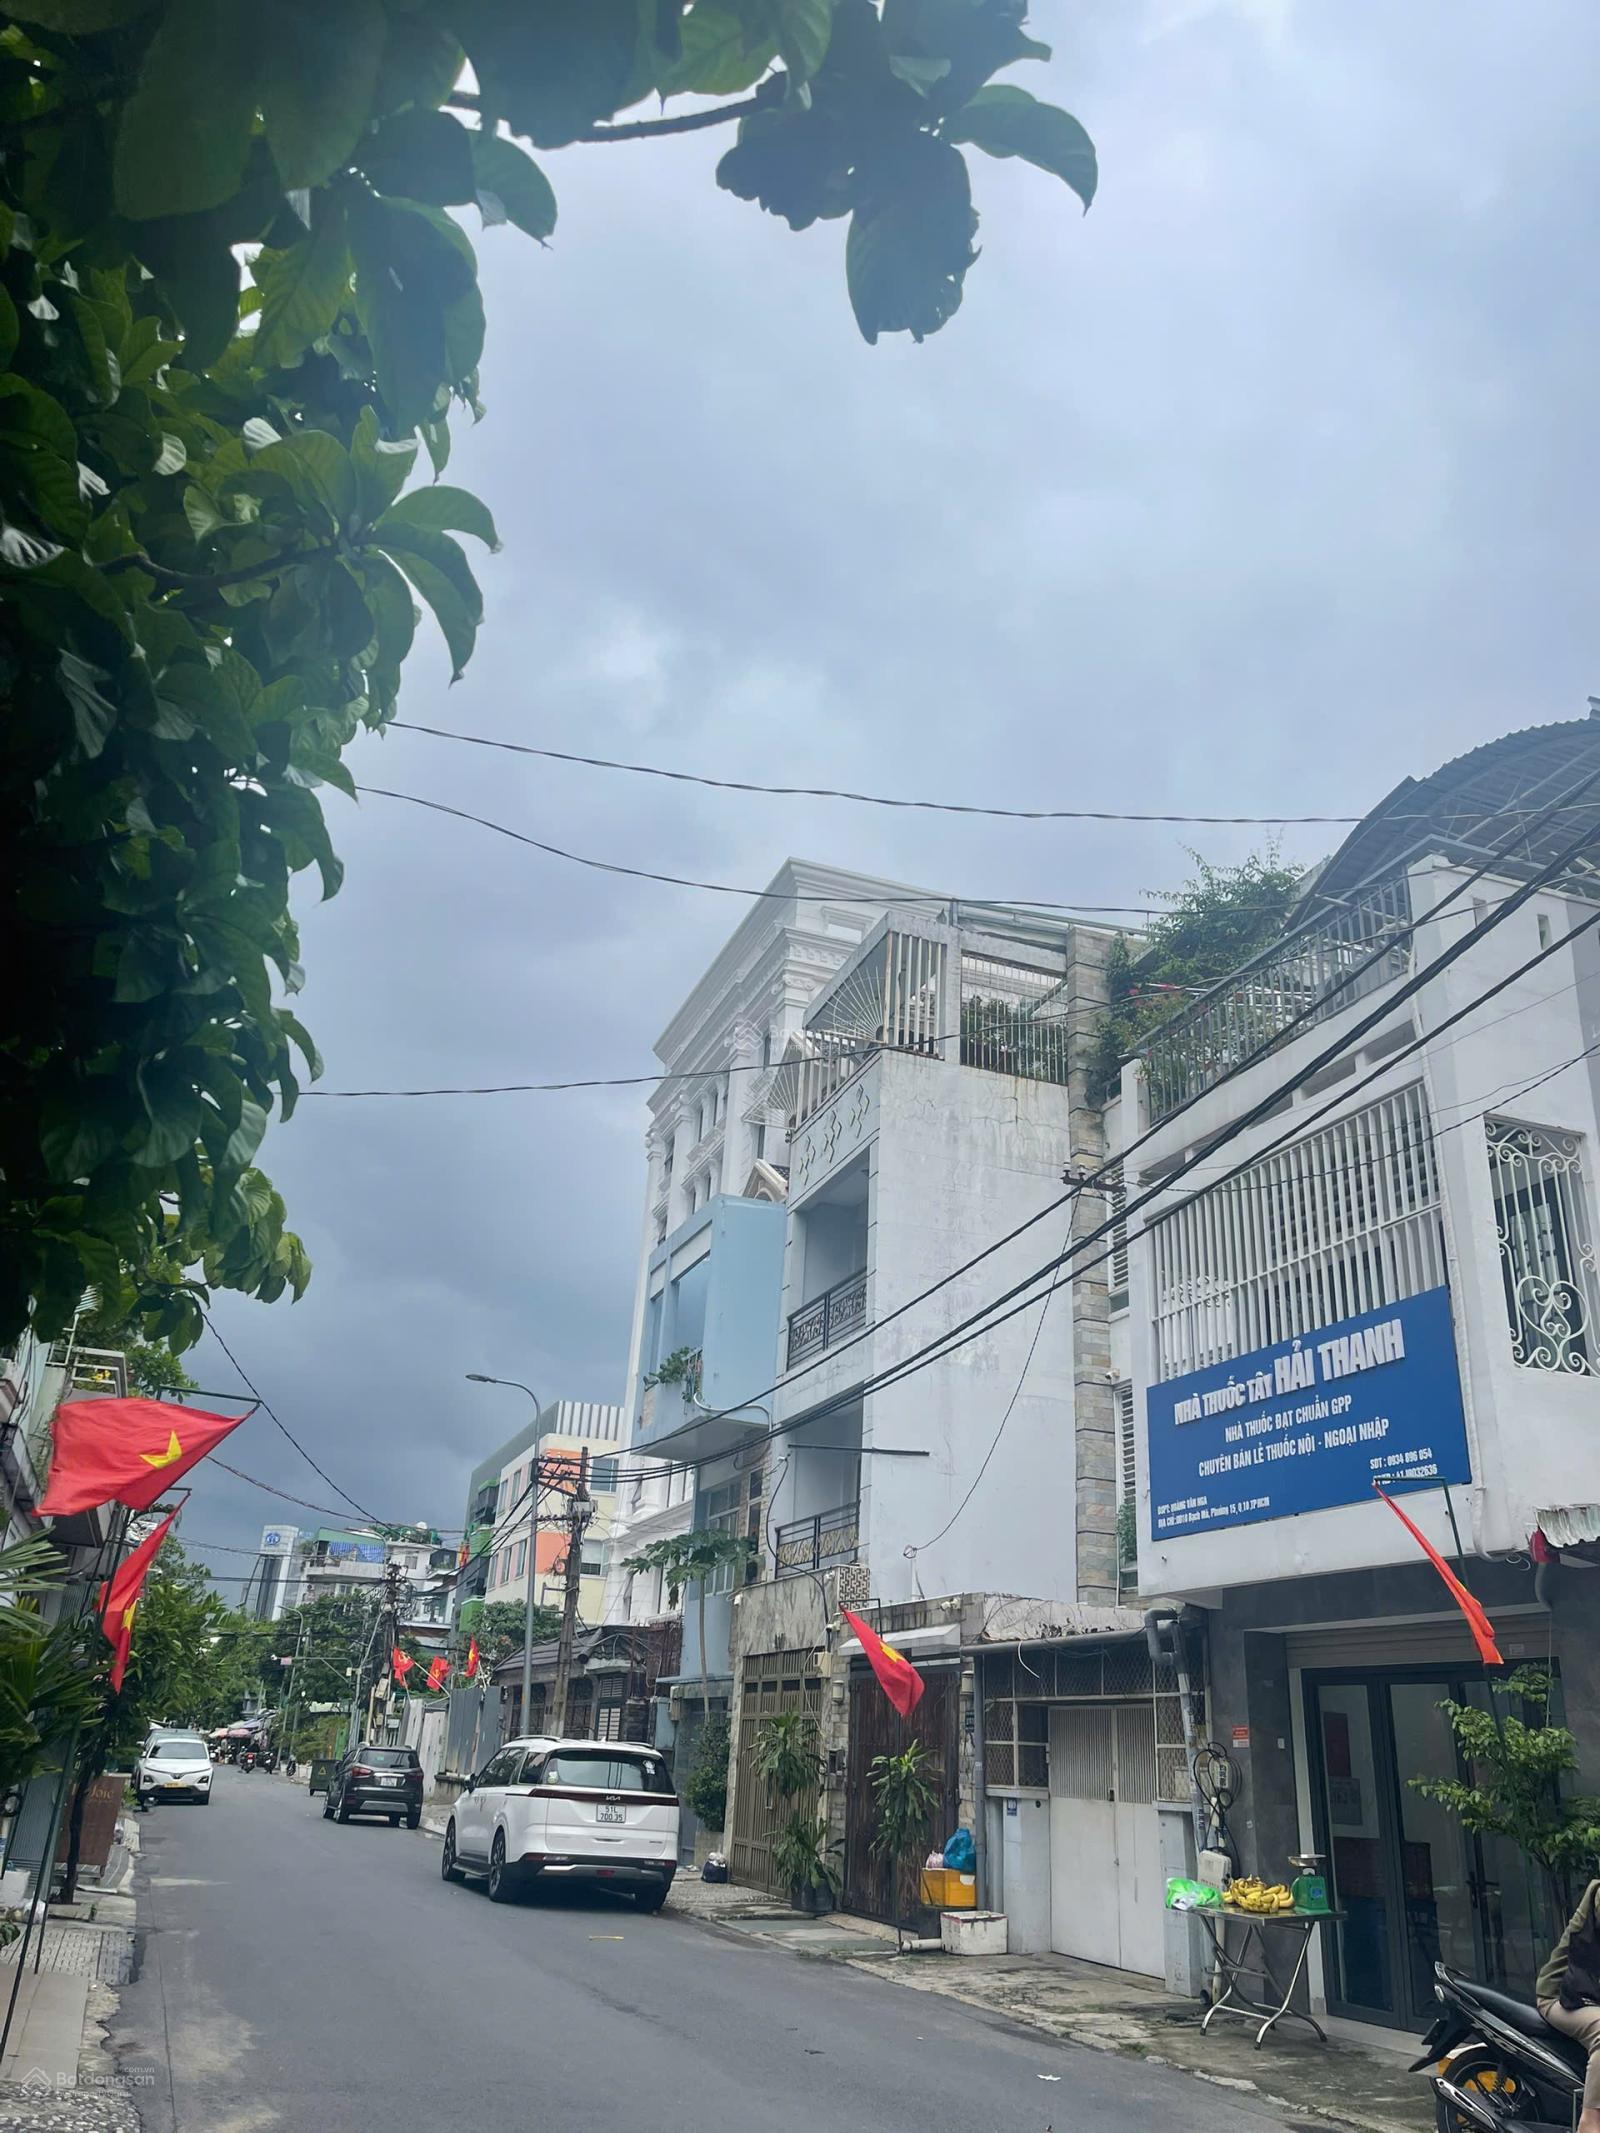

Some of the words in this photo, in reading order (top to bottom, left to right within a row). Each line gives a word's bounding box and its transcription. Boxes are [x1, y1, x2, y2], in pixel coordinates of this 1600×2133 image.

[1174, 1392, 1202, 1425] NHÀ
[1202, 1375, 1246, 1417] THUỐC
[1246, 1371, 1273, 1403] TÂY
[1274, 1339, 1315, 1395] HẢI
[1317, 1318, 1406, 1382] THANH
[1198, 1451, 1232, 1477] CHUYÊN
[1233, 1446, 1253, 1470] BÁN
[1253, 1442, 1265, 1464] LẺ
[1266, 1433, 1297, 1461] THUỐC
[1297, 1434, 1316, 1457] NỘI
[1324, 1428, 1358, 1450] NGOẠI
[1359, 1416, 1389, 1442] NHẬP
[1225, 1426, 1244, 1443] NHÀ
[1245, 1410, 1273, 1437] THUỐC
[1275, 1411, 1294, 1430] ĐẠT
[1295, 1394, 1330, 1424] CHUẨN
[1331, 1394, 1352, 1416] GPP
